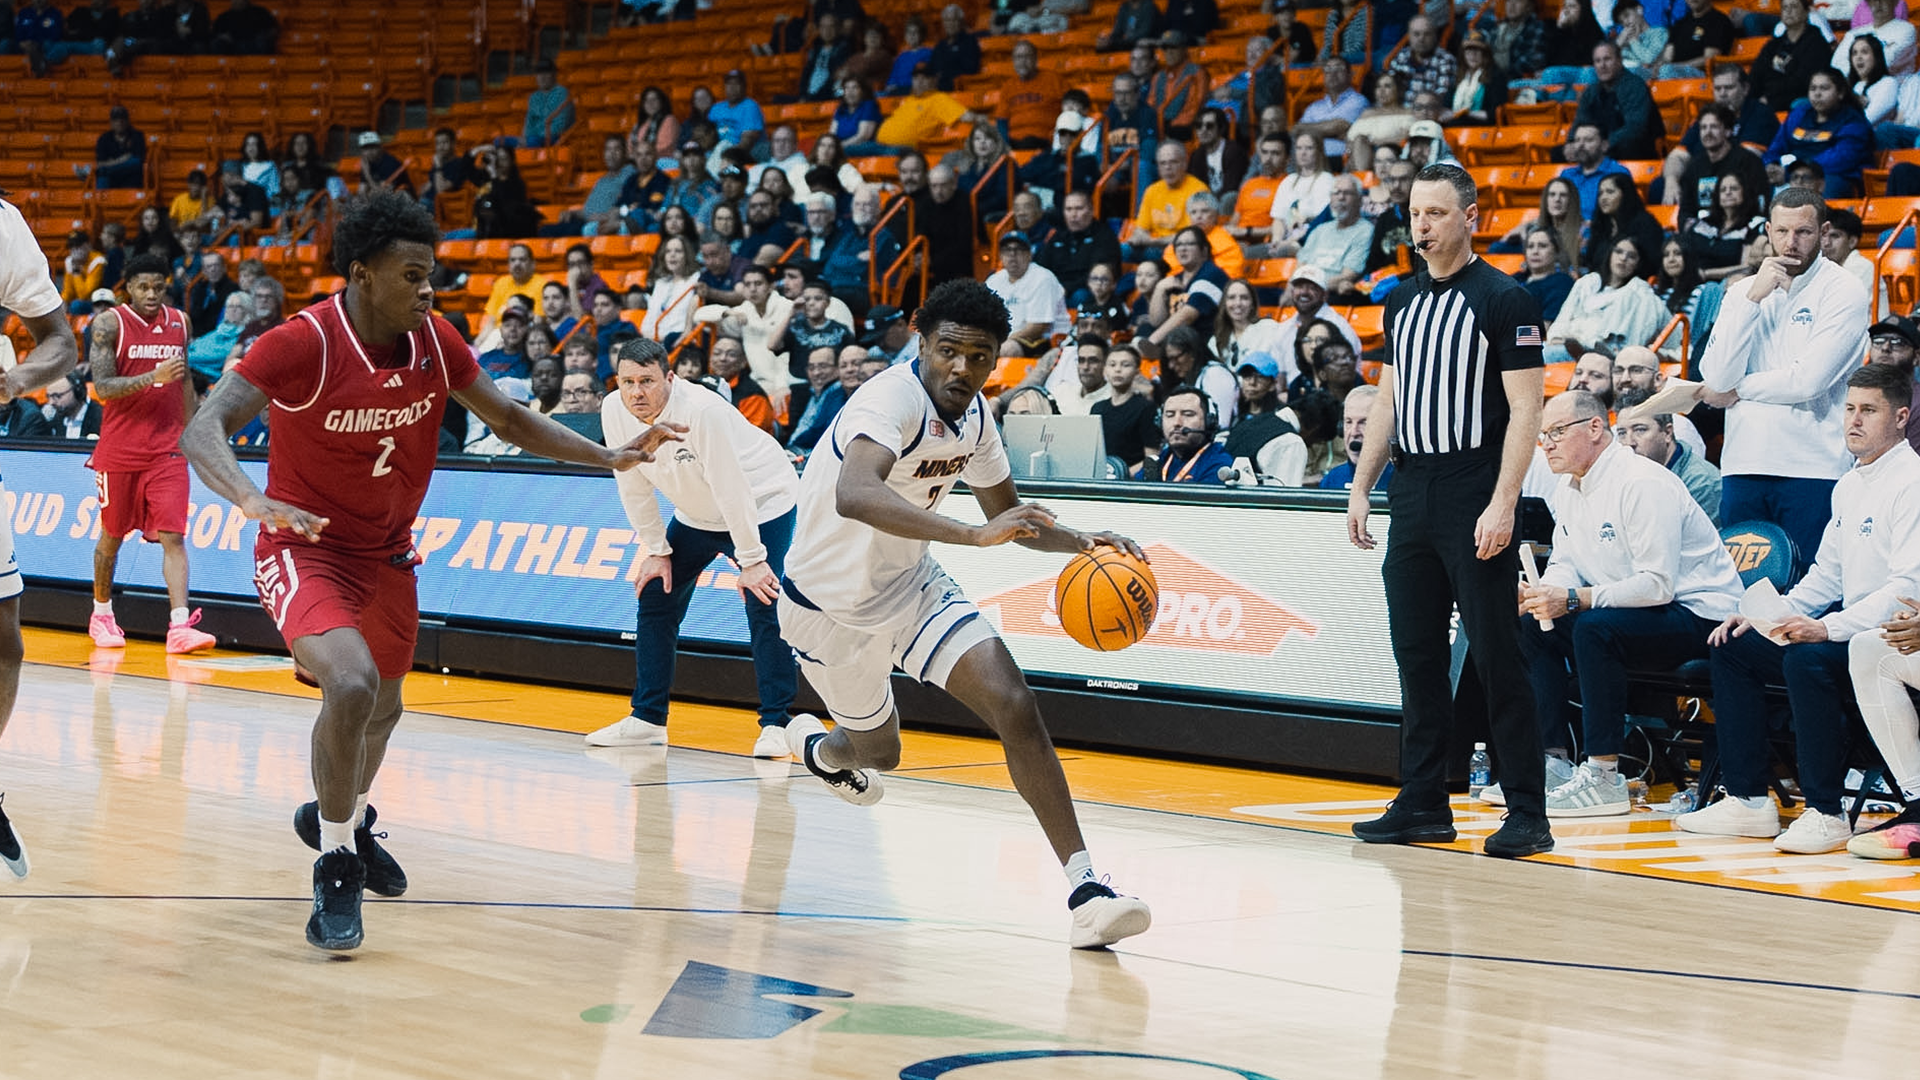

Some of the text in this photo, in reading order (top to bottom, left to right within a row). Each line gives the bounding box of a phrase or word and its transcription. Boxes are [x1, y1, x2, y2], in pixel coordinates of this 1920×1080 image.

[324, 392, 436, 432] GAMECOCKS
[371, 436, 396, 477] 2
[1086, 679, 1140, 691] DAKTRONICS
